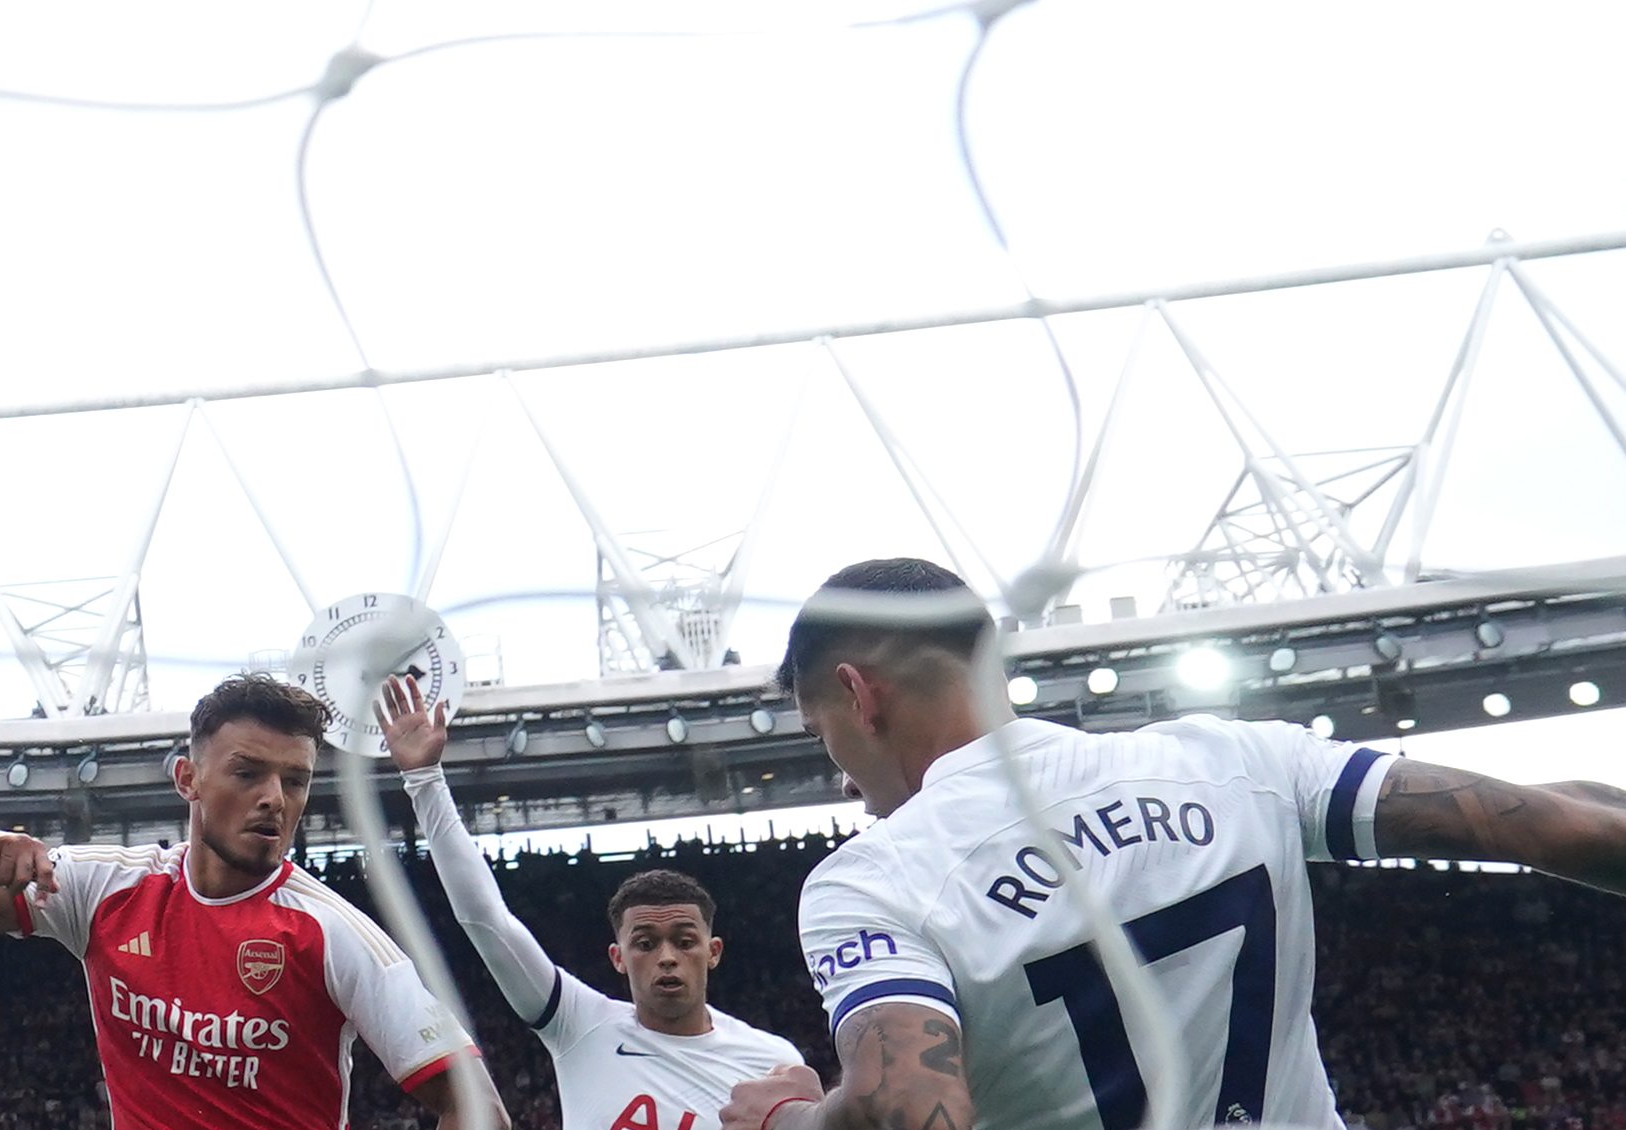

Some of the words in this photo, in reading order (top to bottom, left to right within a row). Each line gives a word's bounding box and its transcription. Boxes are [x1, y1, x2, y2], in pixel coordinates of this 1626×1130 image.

[363, 595, 378, 608] 12
[328, 607, 340, 620] 11
[436, 626, 445, 639] 2
[302, 636, 317, 648] 10
[449, 661, 458, 674] 3
[298, 673, 307, 685] 9
[340, 732, 348, 745] 7
[986, 797, 1215, 919] ROMERO
[244, 948, 279, 960] Arsenal
[109, 976, 290, 1050] Emirates
[170, 1041, 261, 1090] BETTER
